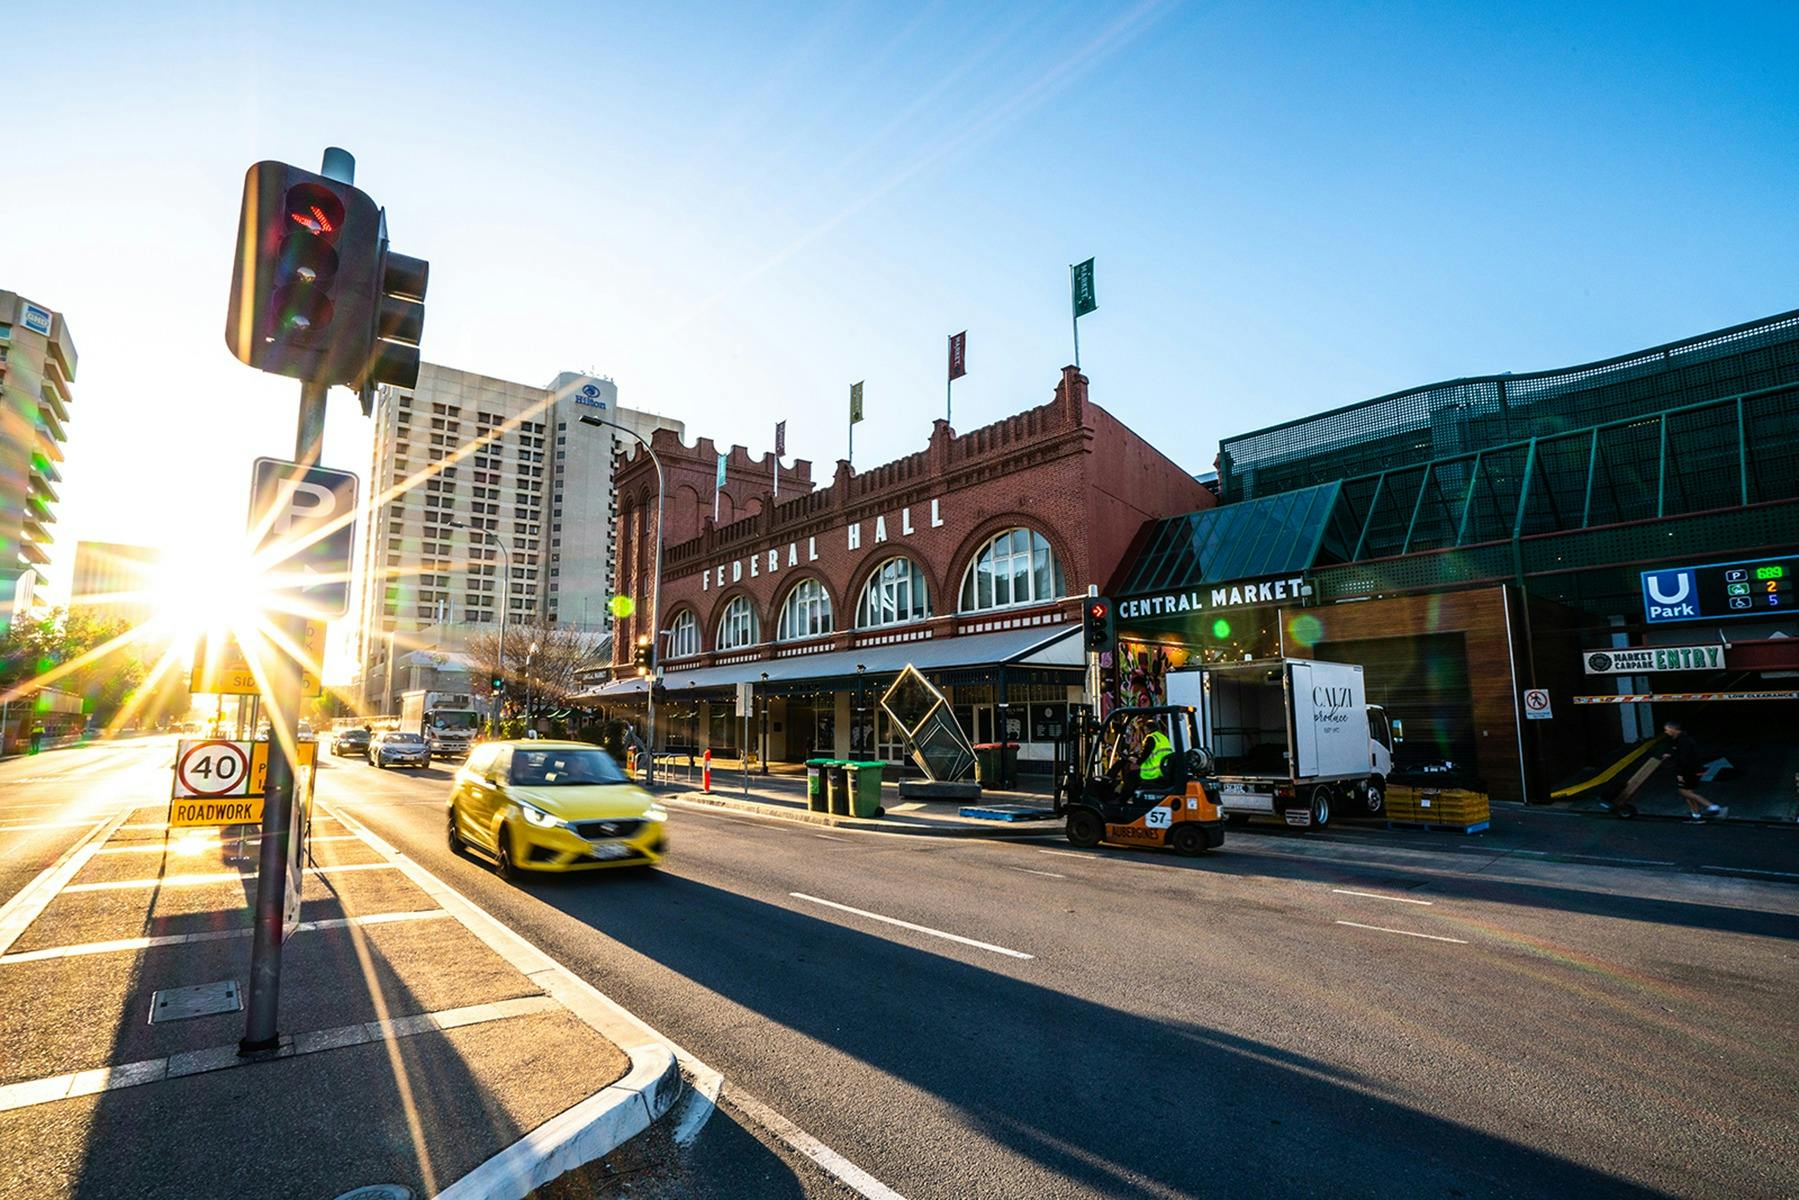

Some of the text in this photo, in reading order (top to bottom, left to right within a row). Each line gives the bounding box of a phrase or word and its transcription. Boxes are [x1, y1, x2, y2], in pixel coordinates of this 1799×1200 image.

[575, 395, 606, 410] Hilton
[272, 478, 336, 536] P
[702, 499, 944, 591] FEDERAL HALL
[1647, 572, 1690, 605] U
[1766, 580, 1778, 593] 2
[1119, 578, 1304, 618] CENTRAL MARKET
[1769, 594, 1778, 607] 5
[1650, 603, 1695, 618] Park
[1613, 647, 1719, 670] MARKET ENTRY
[1614, 661, 1655, 670] CARPARK
[190, 755, 236, 780] 40
[177, 803, 253, 821] ROADWORK
[1150, 811, 1167, 824] 57
